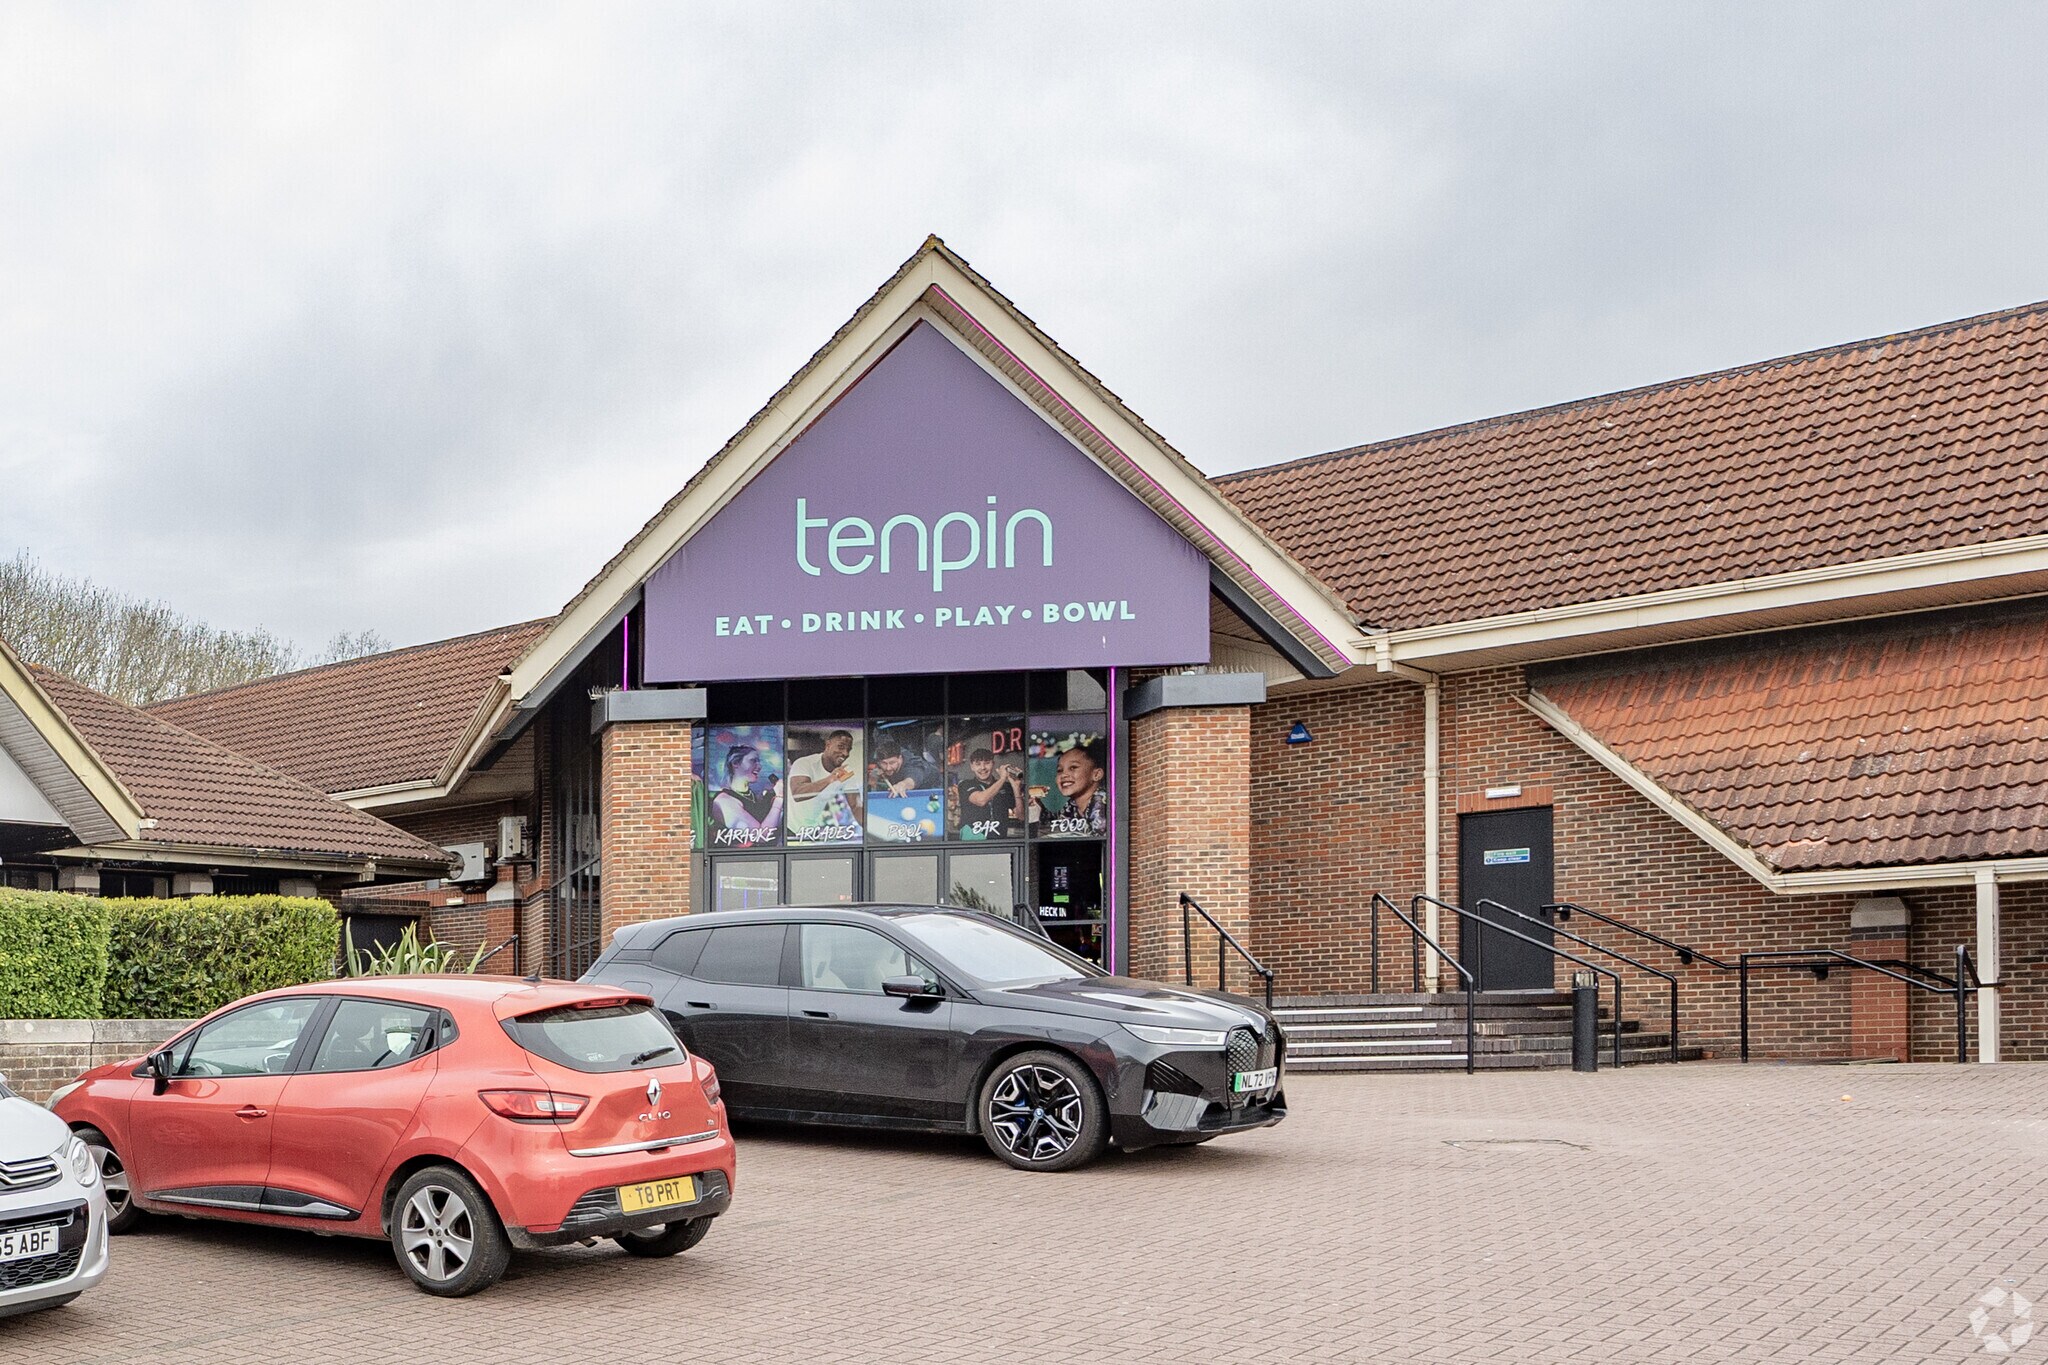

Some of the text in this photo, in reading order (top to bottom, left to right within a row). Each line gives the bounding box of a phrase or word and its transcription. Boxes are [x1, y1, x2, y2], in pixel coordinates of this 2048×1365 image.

[796, 495, 1053, 592] tenpin
[715, 600, 1136, 637] EAT DRINK PLAY BOWL
[795, 824, 856, 842] ARCADES
[887, 823, 923, 839] POOL
[972, 820, 1001, 838] BAR
[1050, 818, 1087, 833] FOOD
[714, 827, 778, 846] KARAOKE
[1059, 907, 1067, 917] IN
[638, 1110, 672, 1122] CLIO
[635, 1181, 680, 1207] T8 PRT
[19, 1230, 51, 1254] ABF
